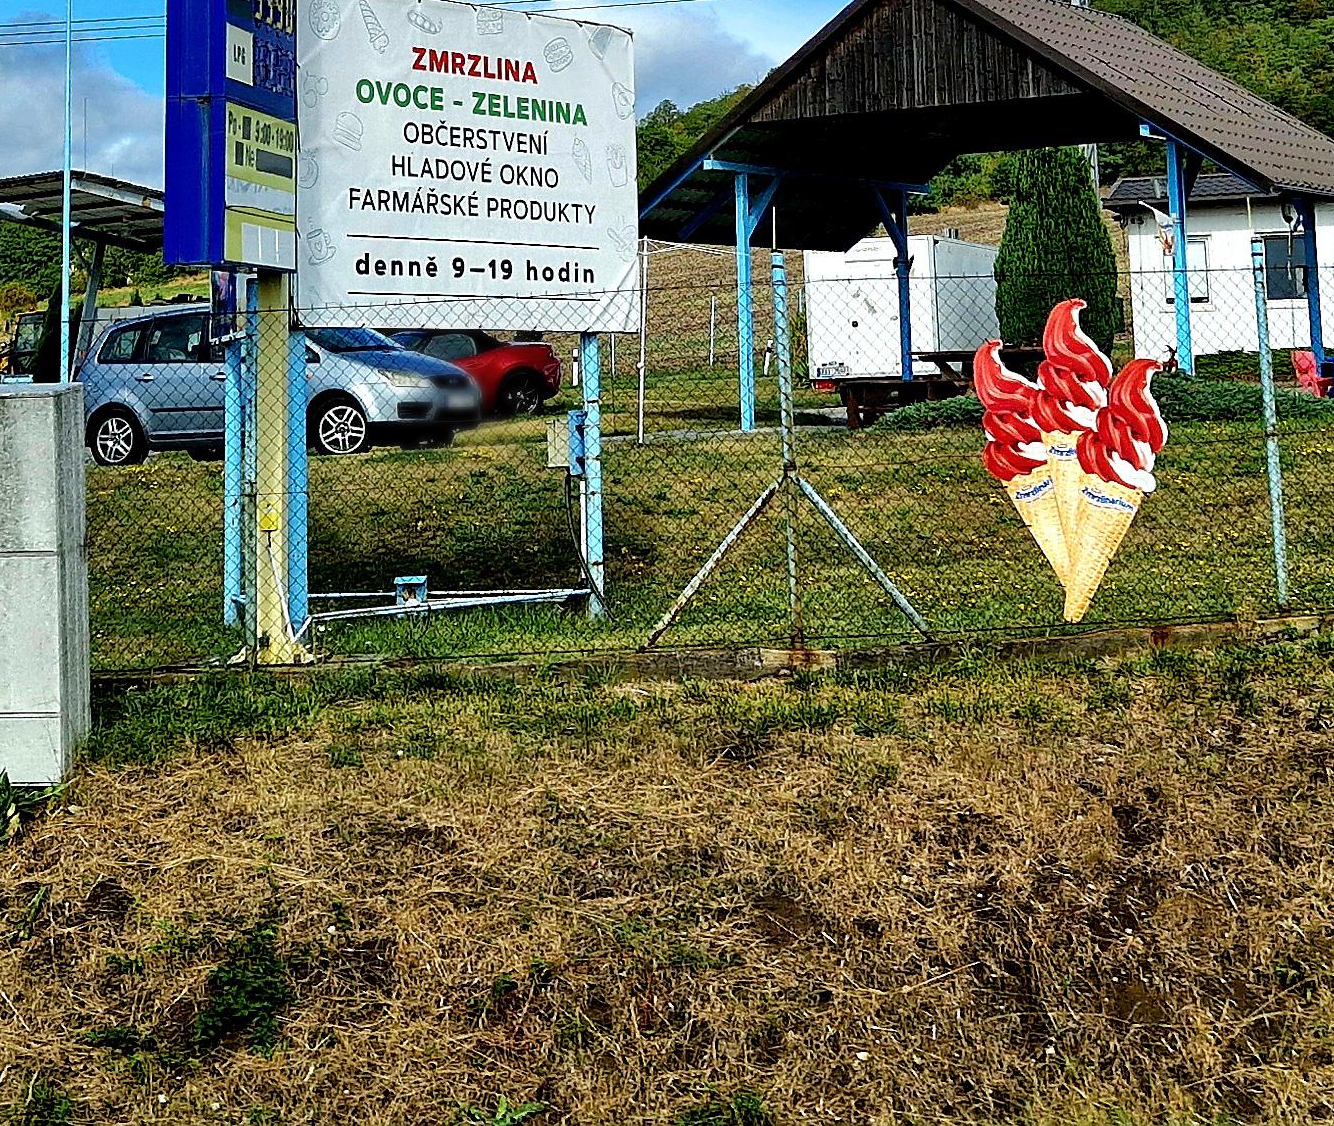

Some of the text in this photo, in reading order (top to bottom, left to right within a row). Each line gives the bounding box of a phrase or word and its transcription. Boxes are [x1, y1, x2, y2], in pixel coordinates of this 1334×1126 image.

[233, 43, 246, 65] LPG
[412, 47, 538, 84] ZMRZLINA
[356, 79, 444, 111] OVOCE
[472, 91, 588, 126] ZELENINA
[403, 120, 549, 155] OBČERSTVENÍ
[391, 155, 559, 188] HLADOVÉ OKNO
[348, 187, 596, 224] FARMÁŘSKÉ PRODUKTY
[355, 253, 438, 278] denně
[526, 260, 595, 284] hodin
